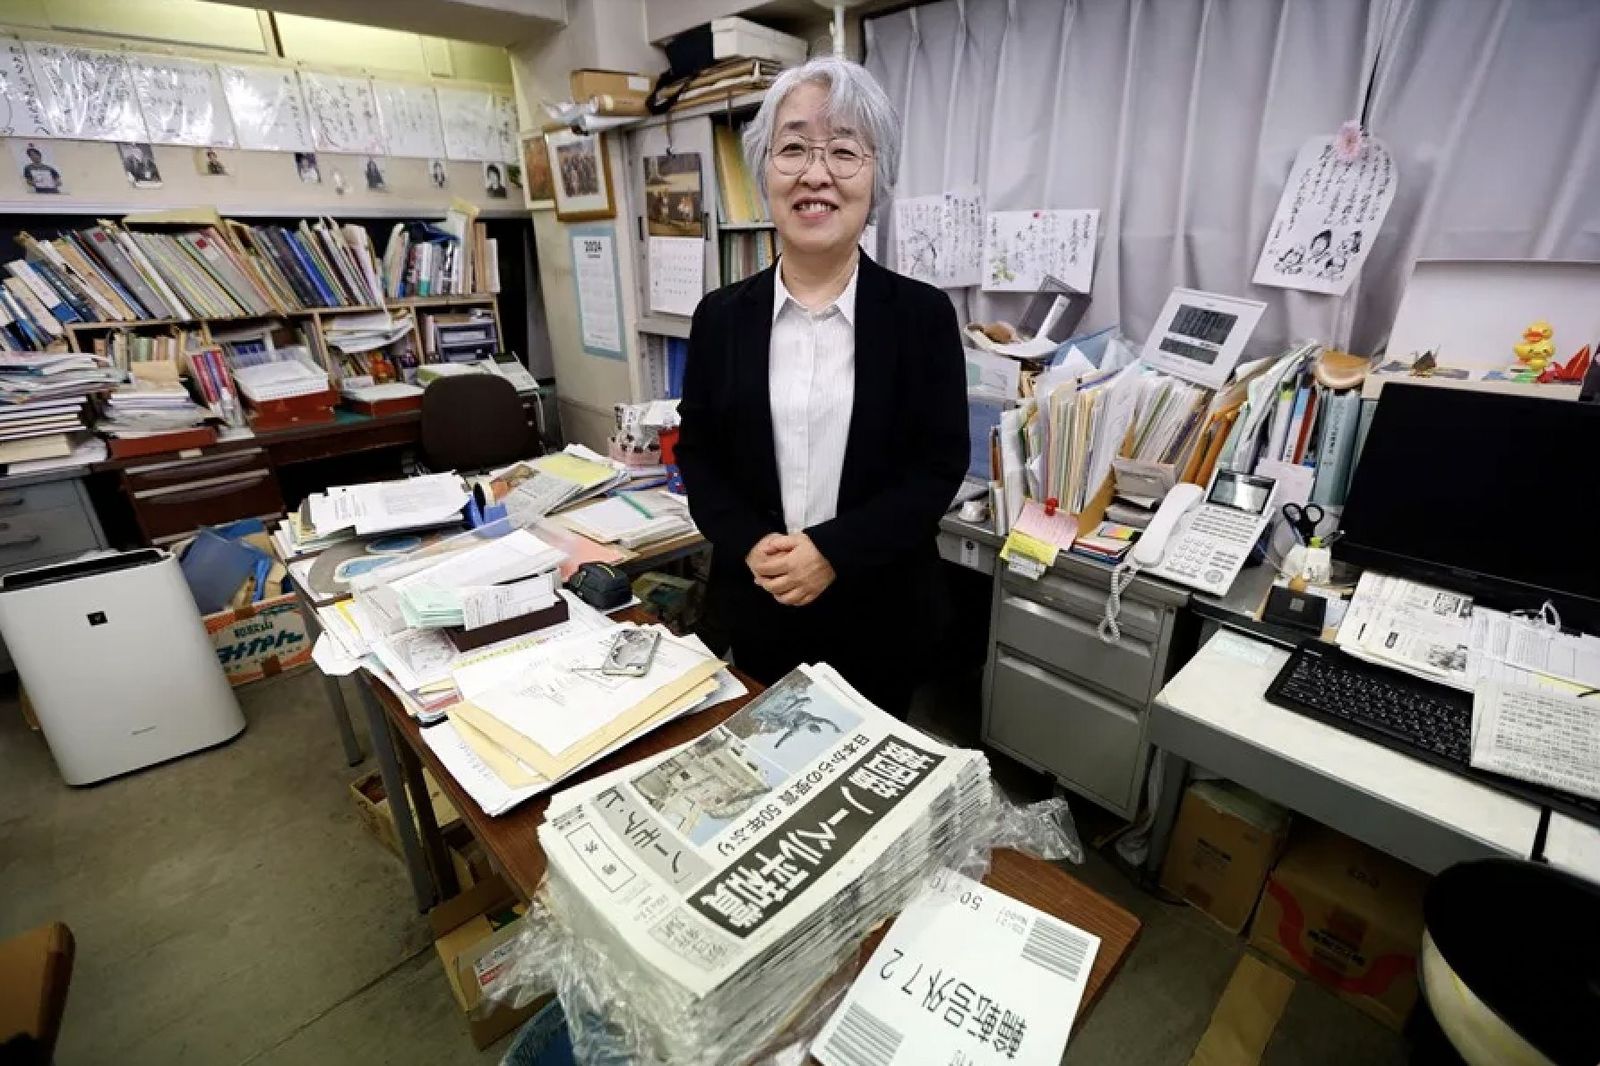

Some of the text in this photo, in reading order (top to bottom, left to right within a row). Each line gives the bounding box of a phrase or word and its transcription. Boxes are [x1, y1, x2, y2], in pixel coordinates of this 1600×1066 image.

[700, 740, 937, 928] 被団協 ノーベル平和賞
[717, 733, 870, 857] 日本からの受賞 50年ぶり
